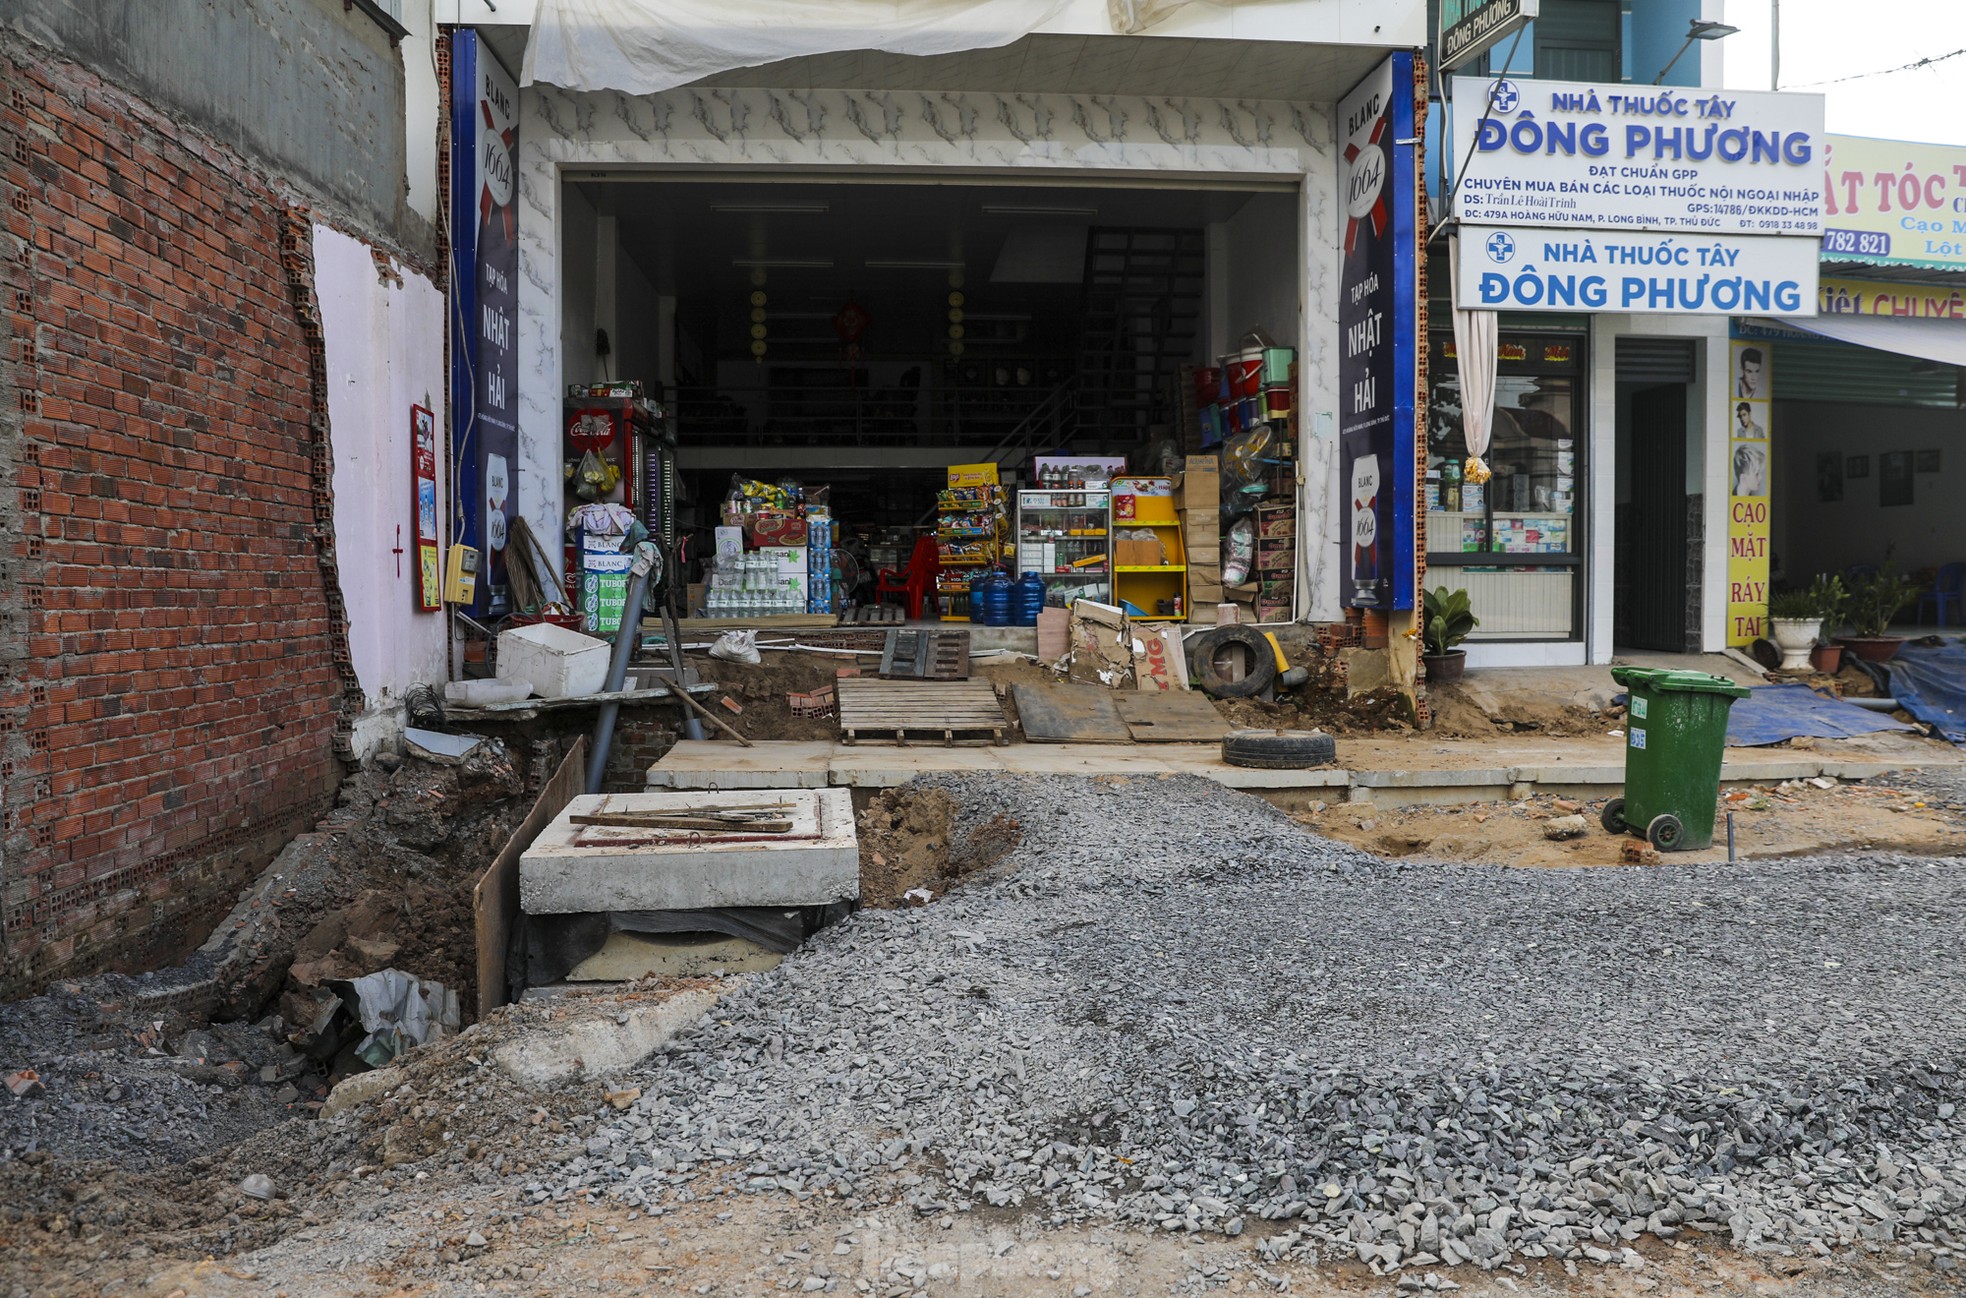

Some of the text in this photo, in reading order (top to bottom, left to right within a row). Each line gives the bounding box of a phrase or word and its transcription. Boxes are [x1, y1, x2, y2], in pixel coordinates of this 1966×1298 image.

[485, 74, 510, 120] BLANC
[1552, 88, 1736, 118] NHÀ THUỐC TÂY
[1349, 92, 1380, 138] BLANC
[1474, 110, 1811, 165] ĐÔNG PHƯƠNG
[484, 143, 510, 190] 1664
[1349, 154, 1382, 205] 1664
[1589, 163, 1698, 180] ĐẠT CHUẨN GPP
[1464, 176, 1819, 203] CHUYÊN MUA BÁN CÁC LOẠI THUỐC NỘI NGOẠI NHẬP
[1464, 194, 1484, 205] DS:
[1485, 193, 1509, 205] Trần
[1510, 194, 1524, 206] Lê
[1525, 196, 1548, 208] Hoài
[1874, 162, 1946, 212] TÓC
[1465, 209, 1721, 227] ĐC: 479A HOÀNG HỮU NAM, P. LONG BÌNH, TP. THỦ ĐỨC
[1739, 219, 1754, 228] ĐT:
[1758, 219, 1779, 228] 0918
[1781, 220, 1792, 229] 33
[1900, 216, 1944, 234] Cạo
[1544, 238, 1740, 267] NHÀ THUỐC TÂY
[1826, 231, 1887, 254] 782 821
[1925, 240, 1963, 257] Lột
[485, 263, 508, 295] TẠP HÓA
[1351, 272, 1379, 306] TẠP HÓA
[1479, 264, 1800, 311] ĐÔNG PHƯƠNG
[483, 304, 509, 356] NHẬT
[1348, 308, 1382, 358] NHẬT
[488, 363, 505, 410] HẢI
[1354, 368, 1375, 414] HẢI
[1358, 475, 1373, 488] BLANC
[1732, 502, 1766, 527] CẠO
[1731, 533, 1766, 562] MẶT
[1731, 576, 1765, 603] RÁY
[1735, 616, 1760, 638] TAI
